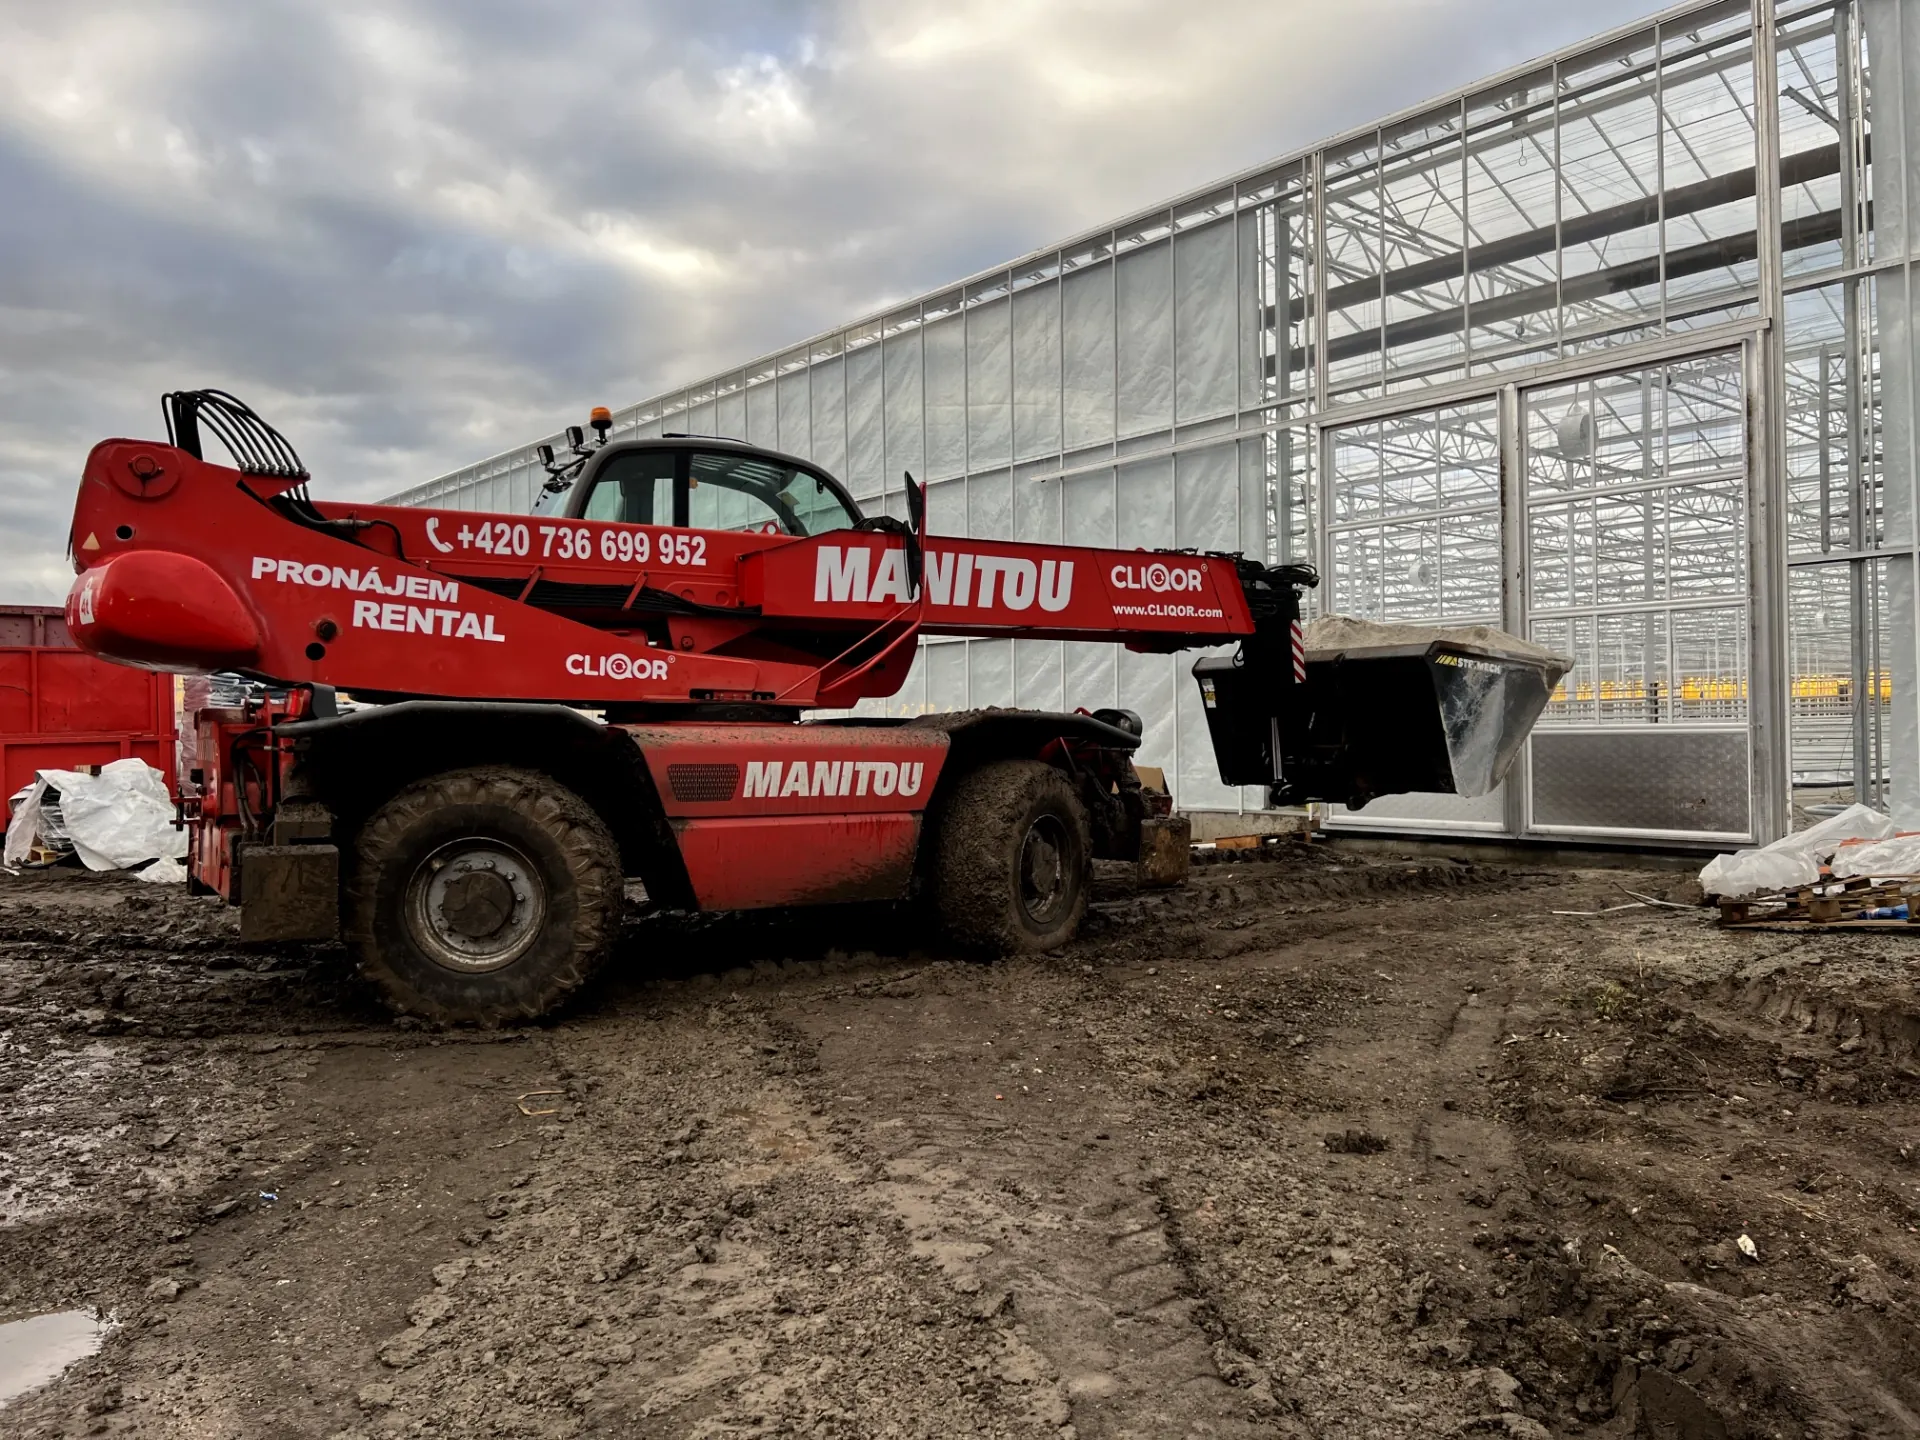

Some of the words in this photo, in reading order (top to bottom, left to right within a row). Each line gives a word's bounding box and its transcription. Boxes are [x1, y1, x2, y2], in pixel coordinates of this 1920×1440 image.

[457, 522, 530, 556] +420
[539, 526, 592, 559] 736
[600, 530, 651, 563] 699
[659, 534, 707, 566] 952
[251, 556, 459, 603] PRONÁJEM
[814, 545, 1074, 612] MANITOU
[352, 600, 506, 642] RENTAL
[1112, 604, 1223, 618] www.CLIQOR.com
[743, 761, 924, 797] MANITOU
